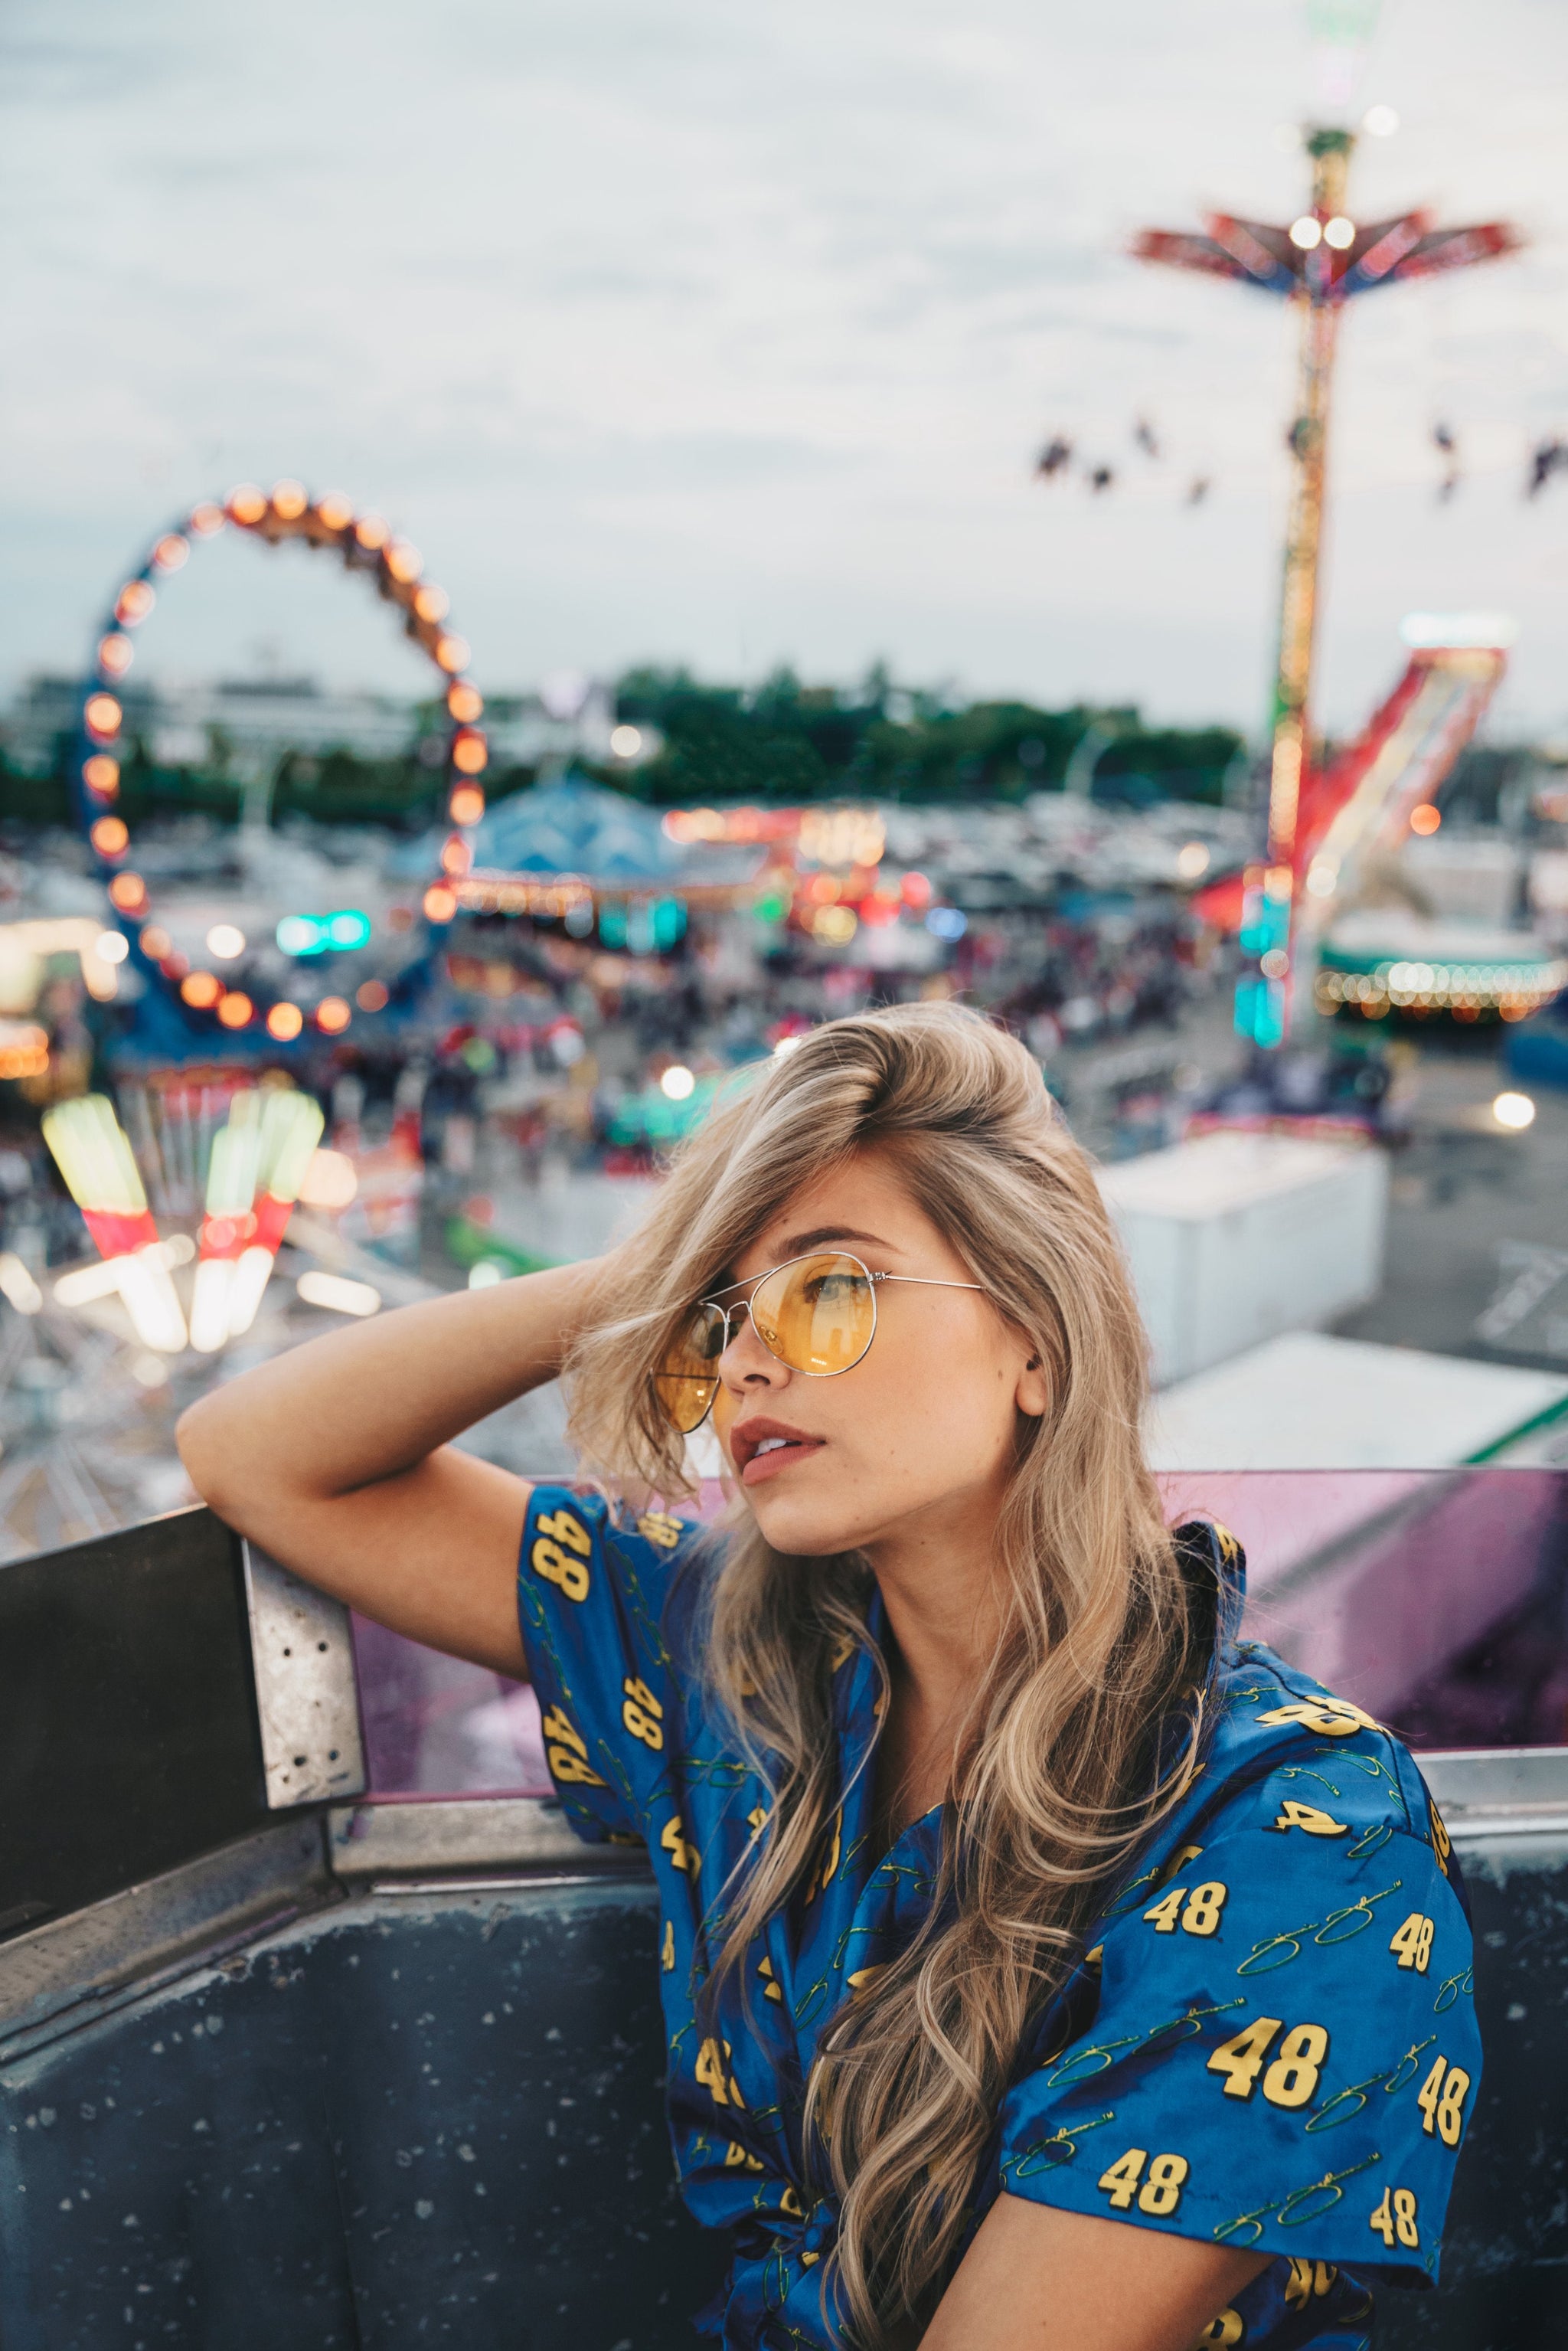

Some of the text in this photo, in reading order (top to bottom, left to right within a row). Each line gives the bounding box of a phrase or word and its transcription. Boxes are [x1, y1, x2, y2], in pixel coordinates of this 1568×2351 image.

[532, 1512, 591, 1601] 48
[543, 1704, 608, 1786] 48
[623, 1679, 662, 1749] 48
[1145, 1882, 1226, 1934] 48
[1391, 1914, 1433, 1971] 48
[1208, 2018, 1328, 2106] 48
[1419, 2056, 1469, 2145] 48
[1099, 2149, 1187, 2214] 48
[1370, 2189, 1418, 2246] 48
